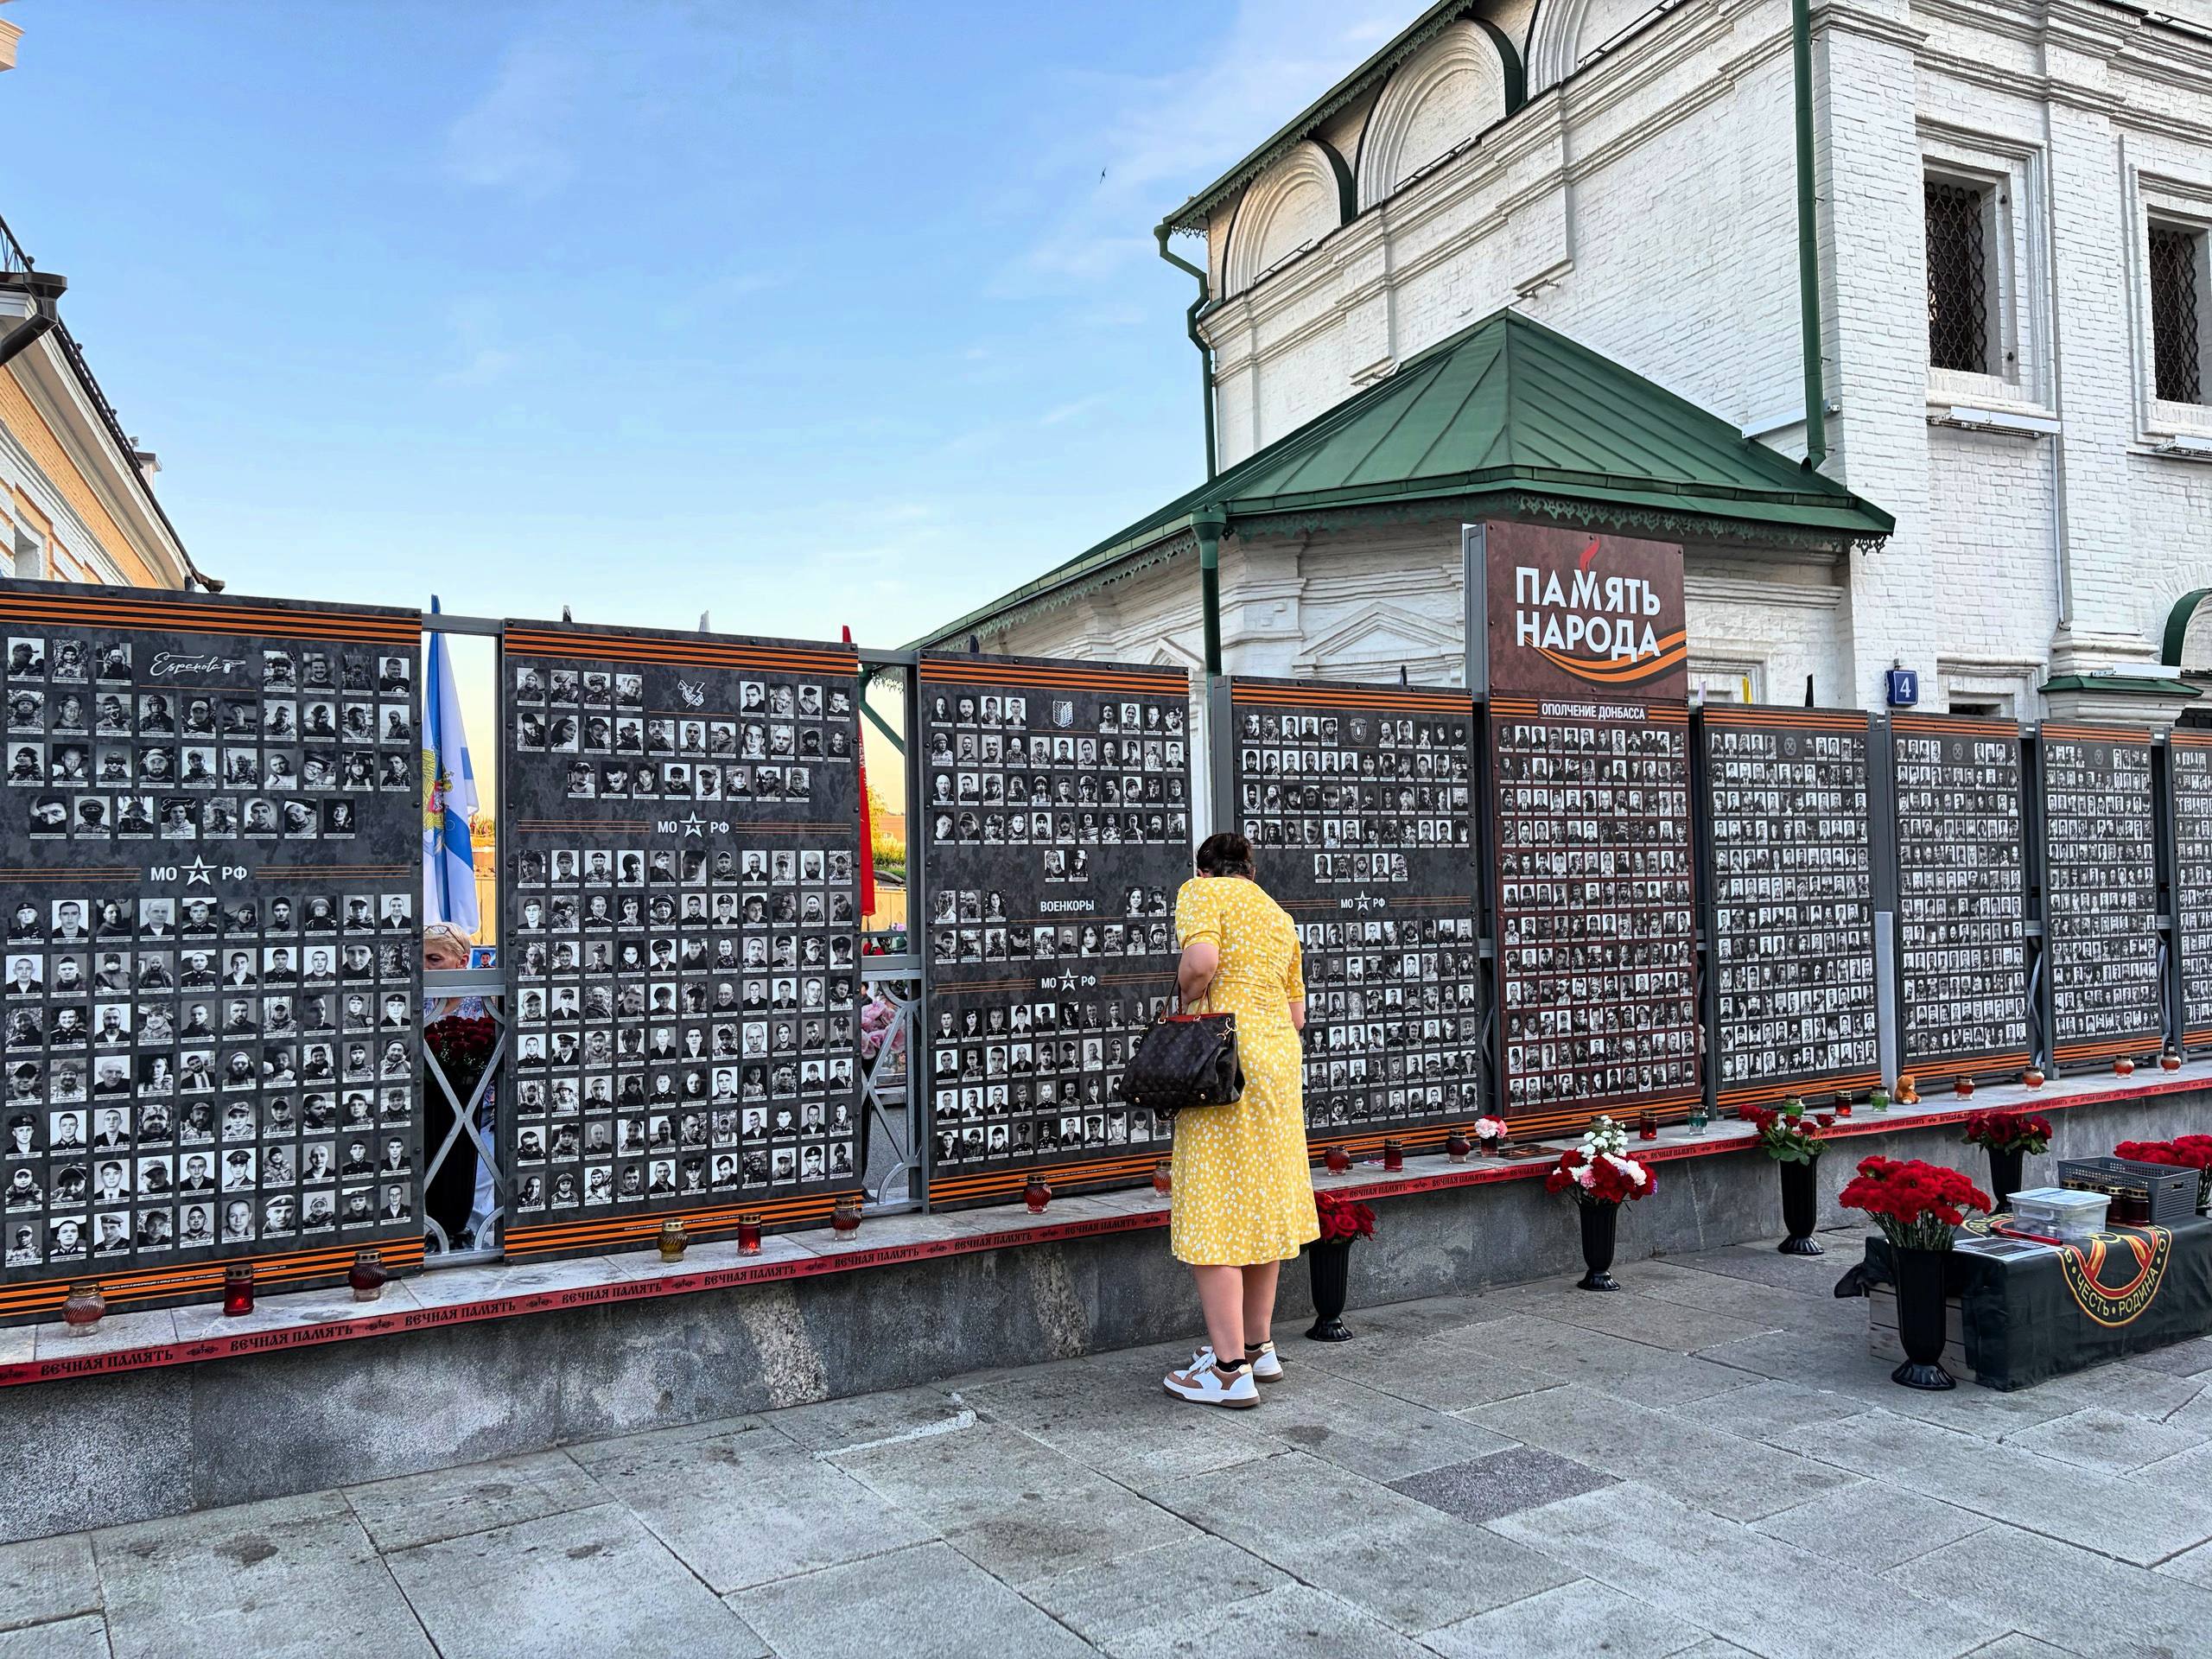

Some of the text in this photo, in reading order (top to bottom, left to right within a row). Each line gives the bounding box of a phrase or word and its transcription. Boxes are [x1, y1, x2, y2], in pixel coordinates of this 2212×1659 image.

[1516, 566, 1662, 616] ПАМЯТЬ
[1516, 610, 1662, 663] НАРОДА
[1899, 677, 1911, 698] 4
[1541, 702, 1645, 721] ОПОЛЧЕНИЕ ДОНБАССА
[658, 820, 730, 834] МО РФ
[150, 865, 248, 881] МО РФ
[1040, 899, 1095, 912] ВОЕНКОРЫ
[1340, 897, 1386, 909] МО РФ
[1041, 975, 1096, 989] МО РФ
[877, 1247, 919, 1262] ПАМЯТЬ
[704, 1264, 797, 1286] ВЕЧНАЯ ПАМЯТЬ
[562, 1282, 662, 1304] ВЕЧНАЯ ПАМЯТЬ
[2076, 1268, 2158, 1317] ЧЕСТЬ РОДИНА
[404, 1300, 516, 1326] ВЕЧНАЯ ПАМЯТЬ
[230, 1325, 353, 1351] ВЕЧНАЯ ПАМЯТЬ
[41, 1349, 174, 1376] ВЕЧНАЯ ПАМЯТЬ
